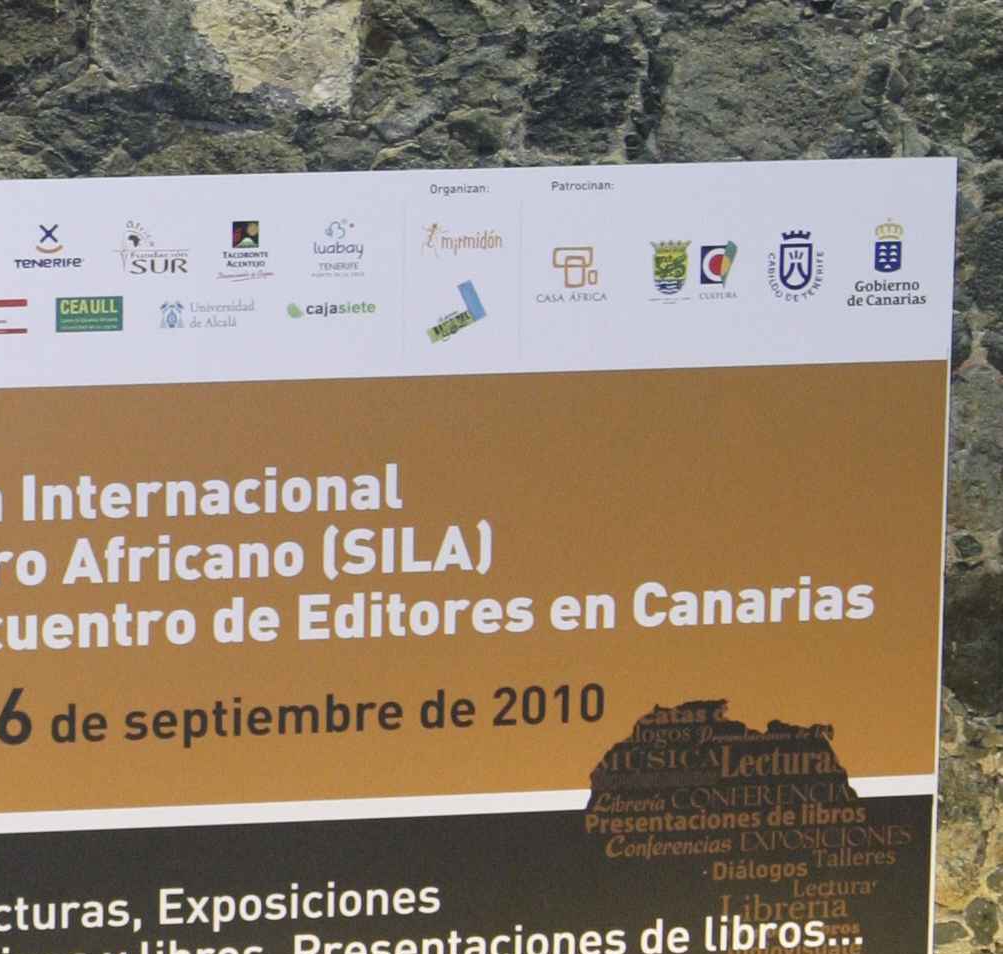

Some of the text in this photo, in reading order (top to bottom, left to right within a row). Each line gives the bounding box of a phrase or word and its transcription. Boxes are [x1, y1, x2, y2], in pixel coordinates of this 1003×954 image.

[429, 183, 490, 196] Organizan:
[551, 181, 615, 191] Patrocinan:
[313, 241, 364, 259] luabay
[441, 231, 503, 255] mirmidón
[129, 258, 188, 274] SUR
[318, 262, 359, 270] TENERIFE
[767, 250, 825, 303] CABILDO DE TENERIFE
[854, 279, 920, 293] Gobierno
[536, 291, 607, 303] CASA ÁFRICA
[699, 291, 738, 300] CULTURA
[847, 292, 927, 306] de Canarias
[59, 298, 119, 315] CEAULL
[189, 300, 255, 313] Universidad
[305, 301, 376, 317] cajasiete
[189, 316, 237, 328] de Alcalá
[22, 462, 403, 522] Internacional
[62, 534, 305, 585] Africano
[322, 518, 493, 581] (SILA)
[213, 596, 281, 644] de
[298, 591, 535, 641] Editores
[550, 593, 615, 631] en
[633, 575, 875, 628] Canarias
[51, 703, 108, 743] de
[123, 693, 403, 749] septiembre
[420, 689, 476, 729] de
[493, 682, 605, 726] 2010
[585, 802, 867, 834] Presentaciones de libros
[605, 824, 912, 860] Conferencias EXPOSICIONES
[814, 848, 896, 868] Talleres
[712, 859, 808, 882] Diálogos
[159, 881, 442, 933] Exposiciones
[720, 893, 849, 923] Librería
[704, 915, 863, 952] libros...
